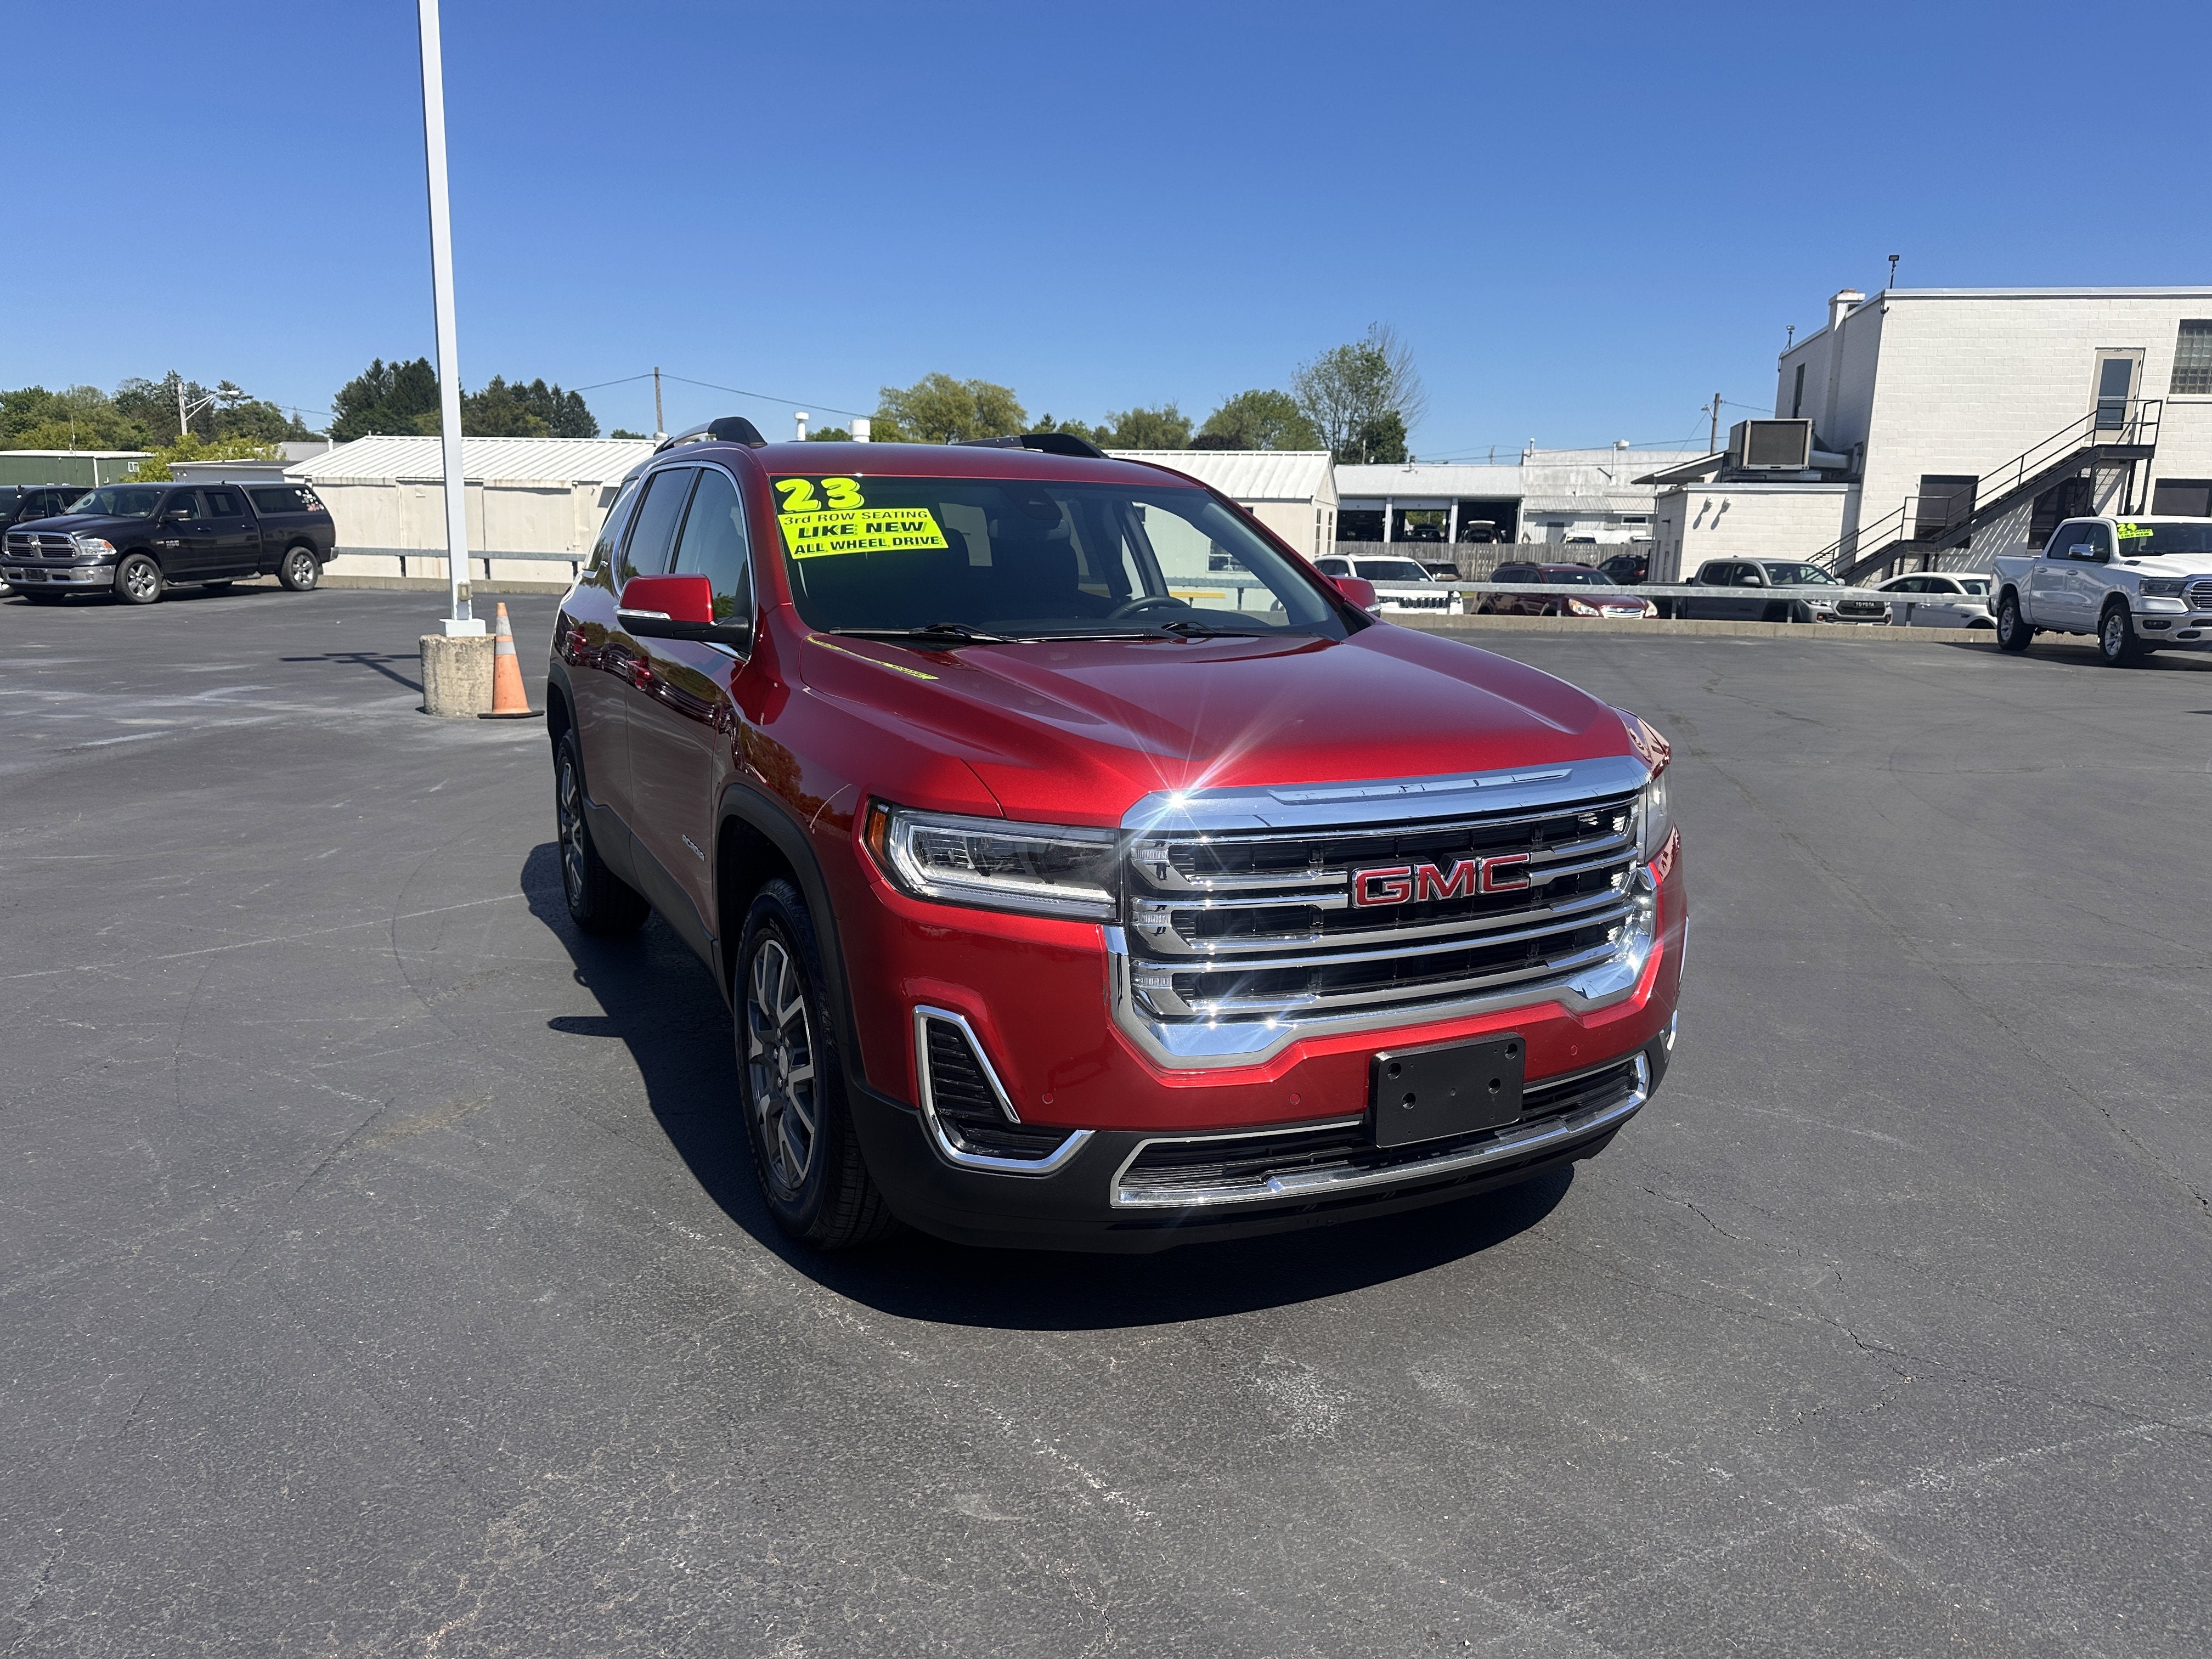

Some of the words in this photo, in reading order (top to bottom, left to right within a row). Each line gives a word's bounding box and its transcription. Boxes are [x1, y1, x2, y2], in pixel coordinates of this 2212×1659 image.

[775, 477, 865, 512] 23
[784, 516, 811, 525] 3rd
[818, 513, 855, 522] ROW
[861, 511, 927, 520] SEATING
[798, 524, 857, 539] LIKE
[866, 522, 926, 534] NEW
[794, 543, 826, 555] ALL
[830, 538, 888, 551] WHEEL
[892, 537, 940, 546] DRIVE
[1351, 852, 1530, 909] GMC
